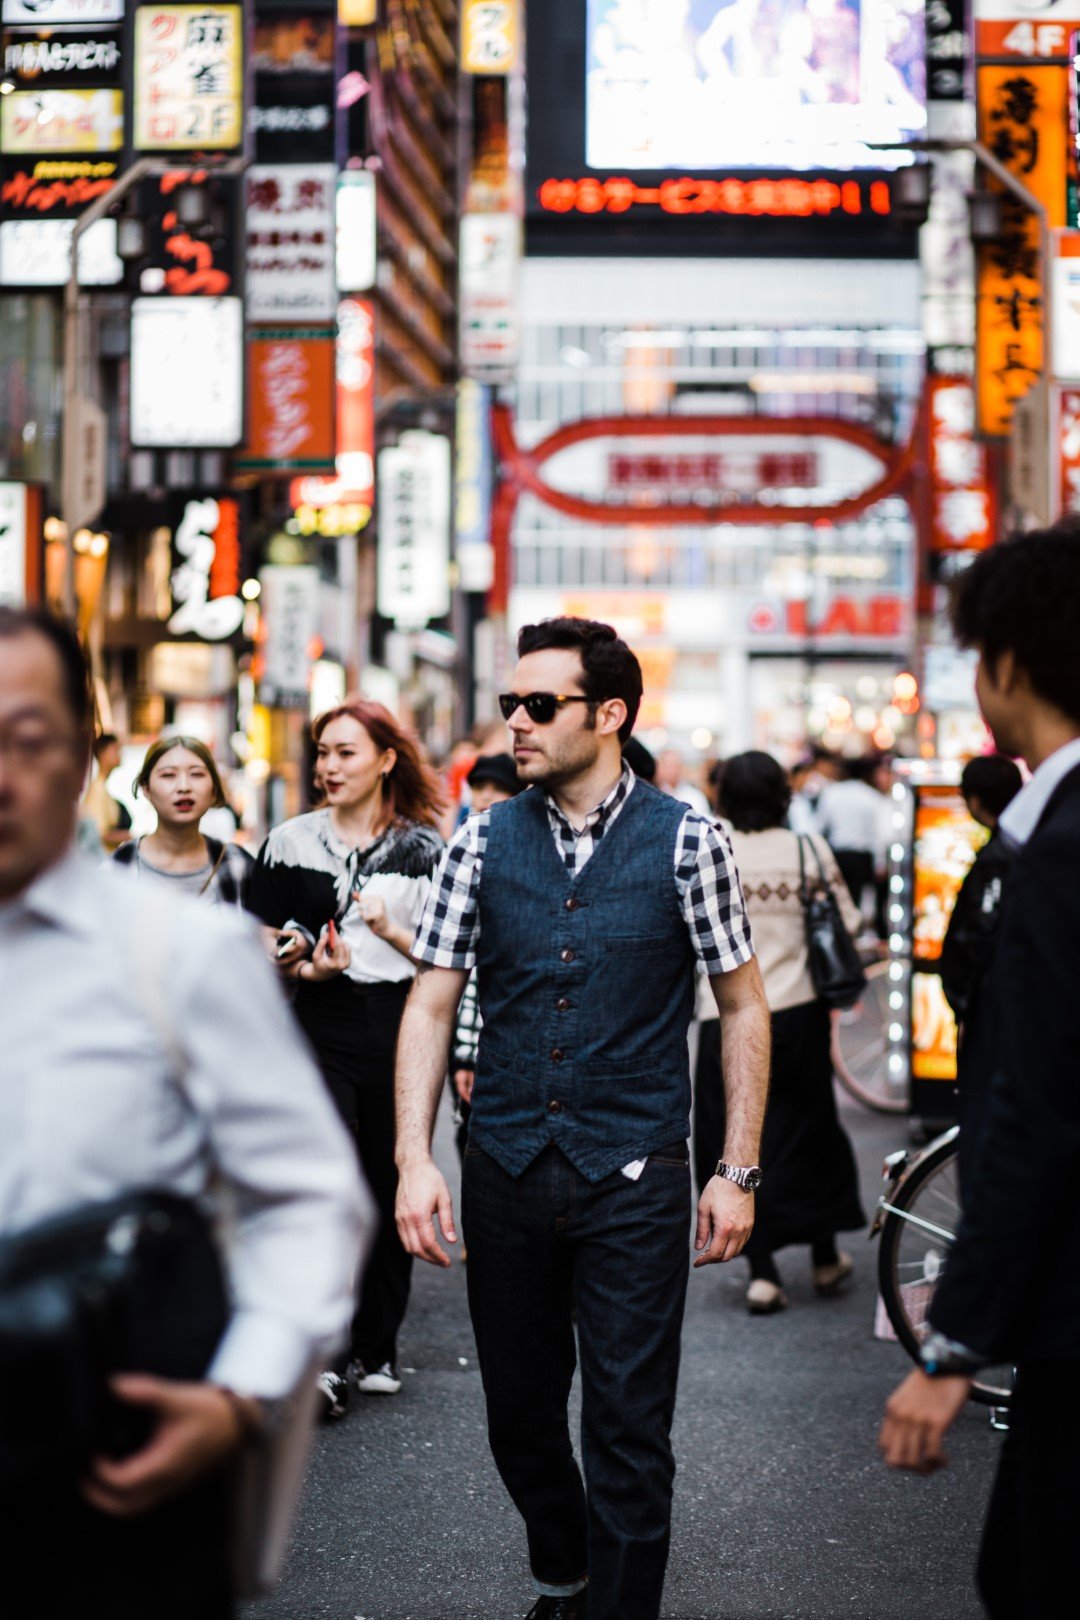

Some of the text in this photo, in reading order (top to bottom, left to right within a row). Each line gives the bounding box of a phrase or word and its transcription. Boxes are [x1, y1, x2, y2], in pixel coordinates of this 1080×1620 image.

[187, 10, 230, 95] 麻雀
[1002, 22, 1066, 56] 4F
[186, 104, 233, 136] 2F
